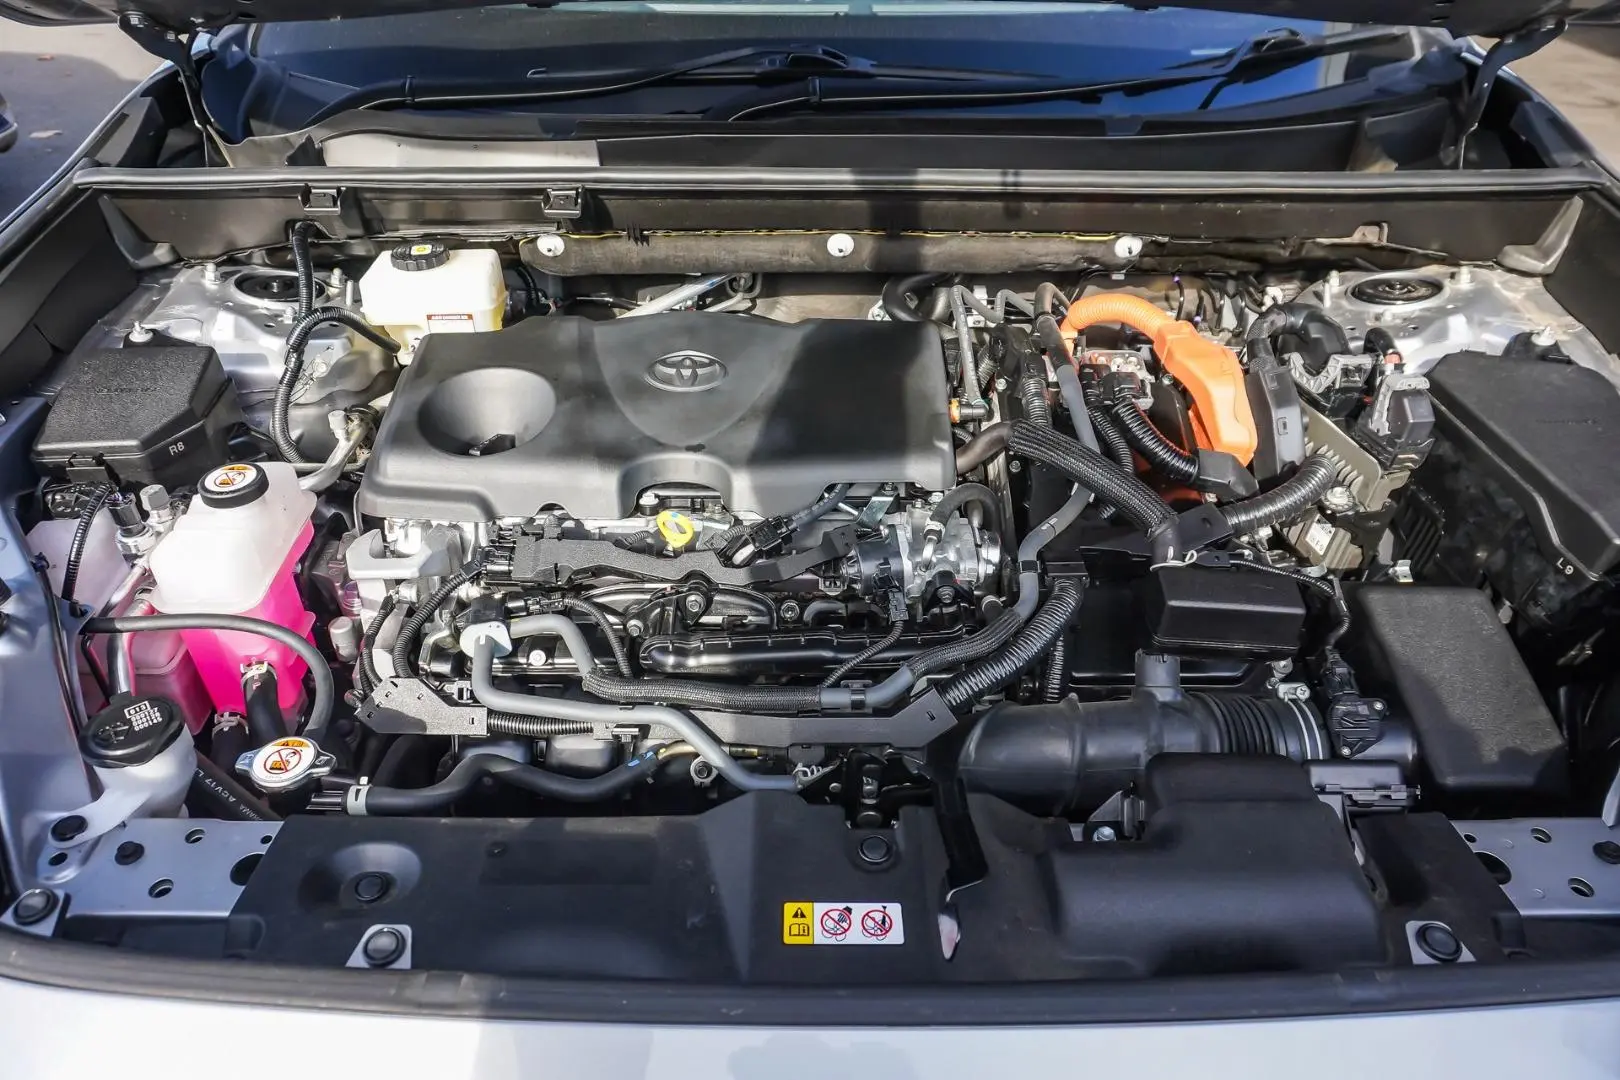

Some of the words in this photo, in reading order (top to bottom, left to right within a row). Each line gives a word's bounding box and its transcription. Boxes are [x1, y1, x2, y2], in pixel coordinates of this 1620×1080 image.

[168, 441, 185, 456] R8
[1556, 557, 1574, 575] L9
[204, 778, 237, 802] ACV17
